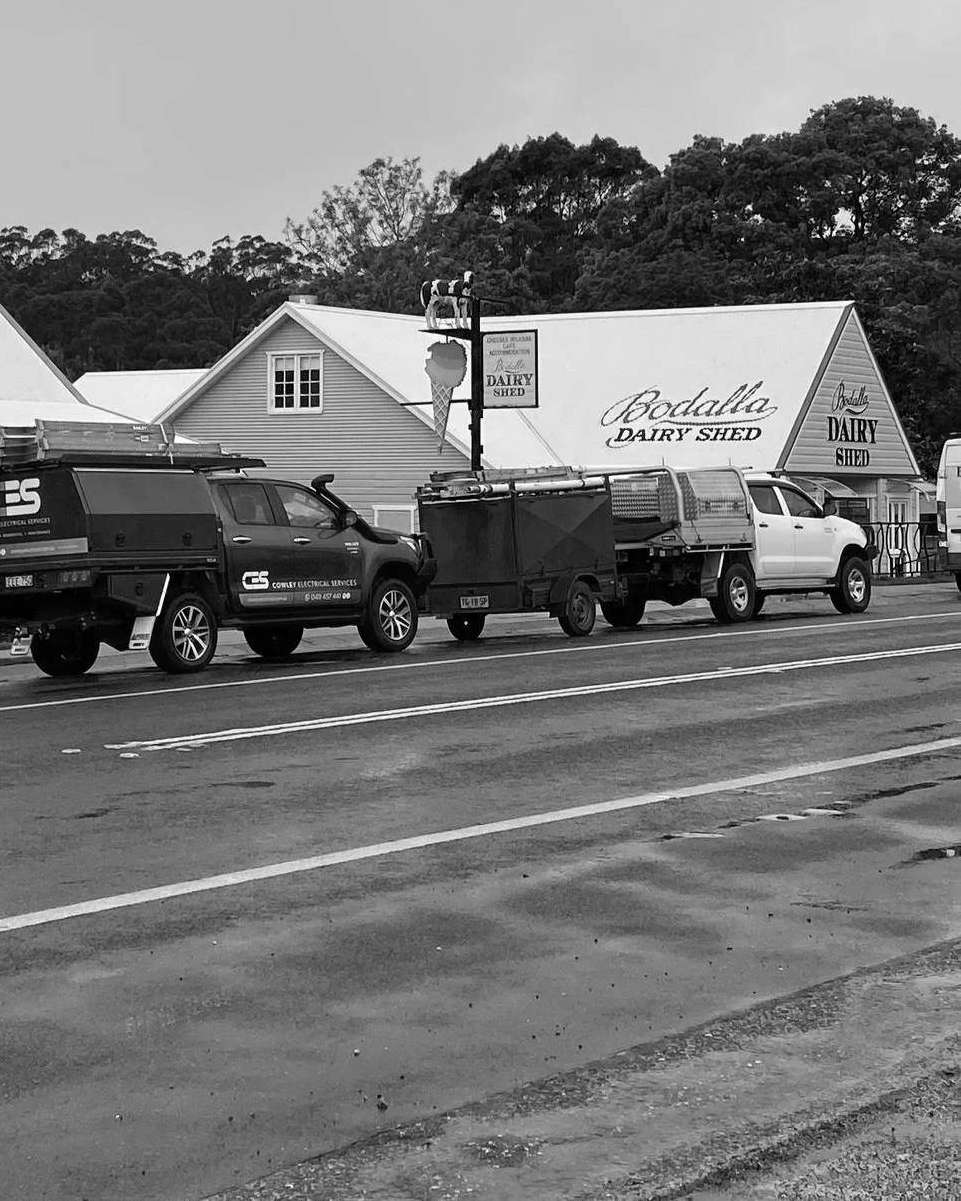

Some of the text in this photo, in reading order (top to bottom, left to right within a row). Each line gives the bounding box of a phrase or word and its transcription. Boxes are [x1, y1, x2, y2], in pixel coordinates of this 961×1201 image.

[486, 373, 533, 387] DAIRY
[493, 387, 525, 397] SHED
[832, 379, 869, 412] Bodalla
[601, 380, 776, 427] Bodalla
[611, 427, 762, 443] DAIRY SHED
[827, 415, 878, 444] DAIRY
[836, 447, 870, 467] SHED
[28, 517, 50, 525] SERVICES
[272, 579, 357, 589] COWLEY ELECTRICAL SERVICES
